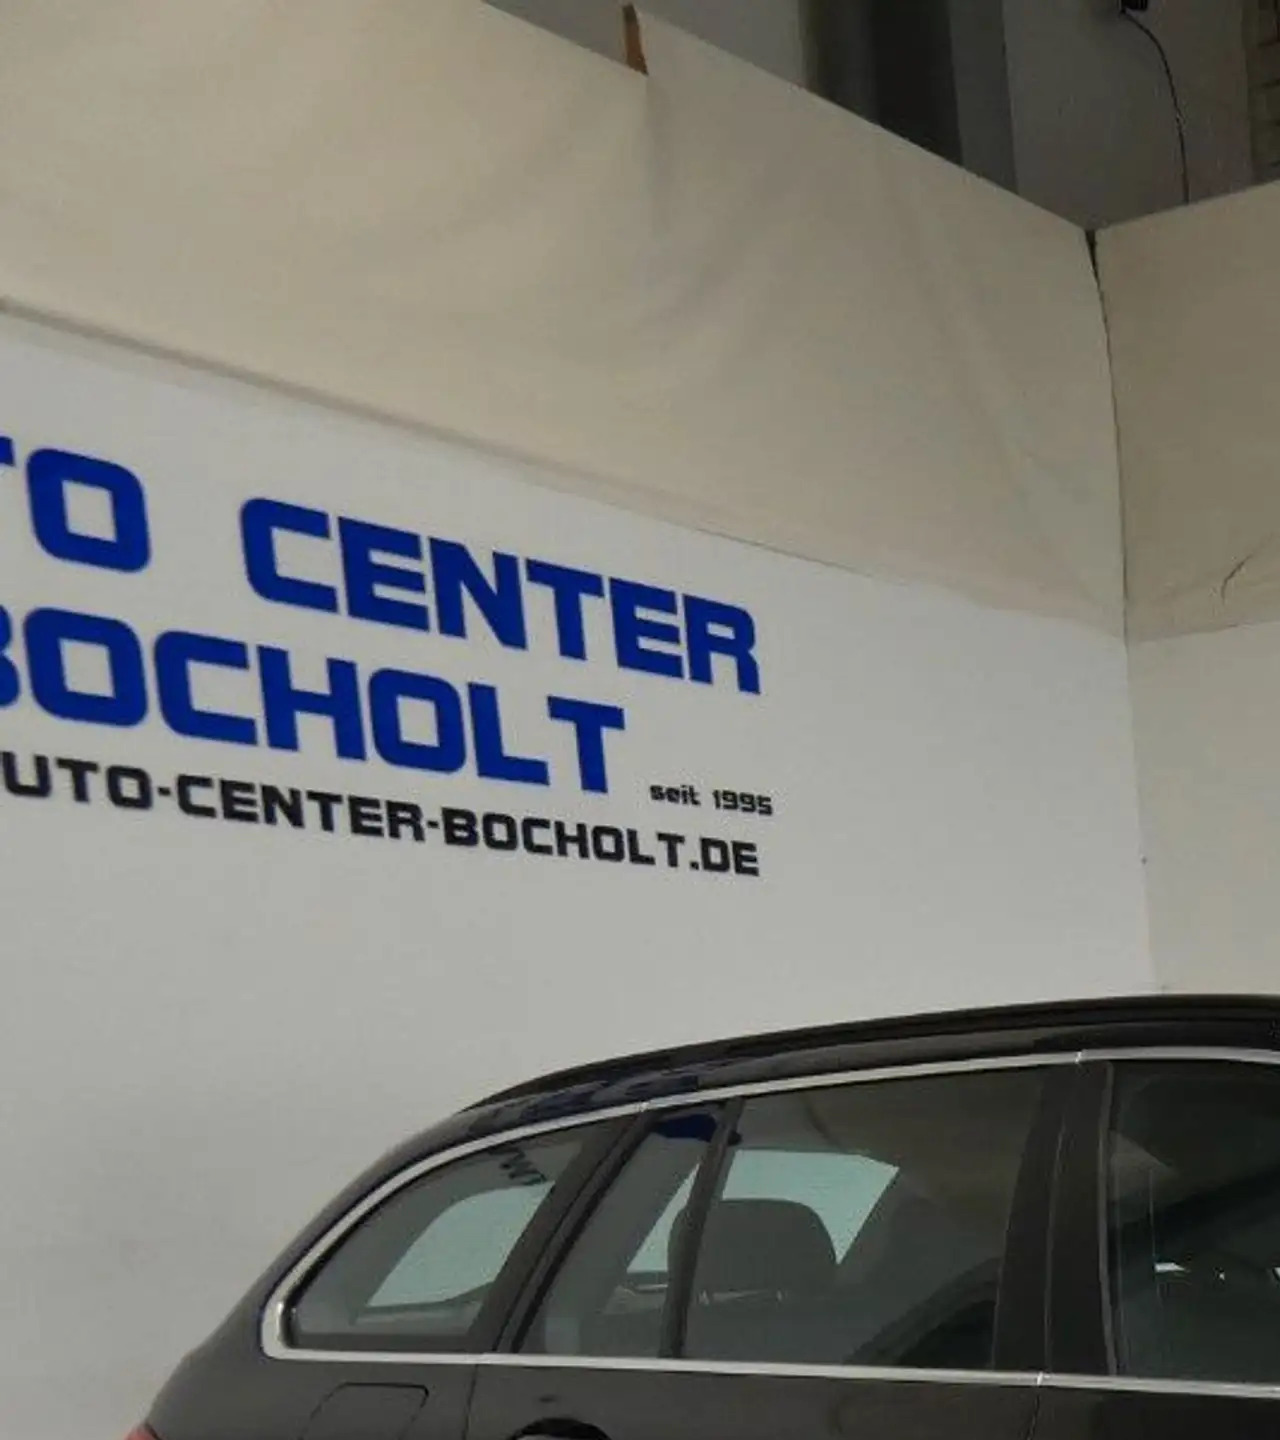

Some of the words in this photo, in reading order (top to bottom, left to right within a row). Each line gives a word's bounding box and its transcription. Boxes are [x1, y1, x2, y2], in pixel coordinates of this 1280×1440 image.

[0, 436, 151, 574] O
[240, 497, 761, 695] CENTER
[649, 784, 702, 807] seit
[711, 789, 773, 817] 1995
